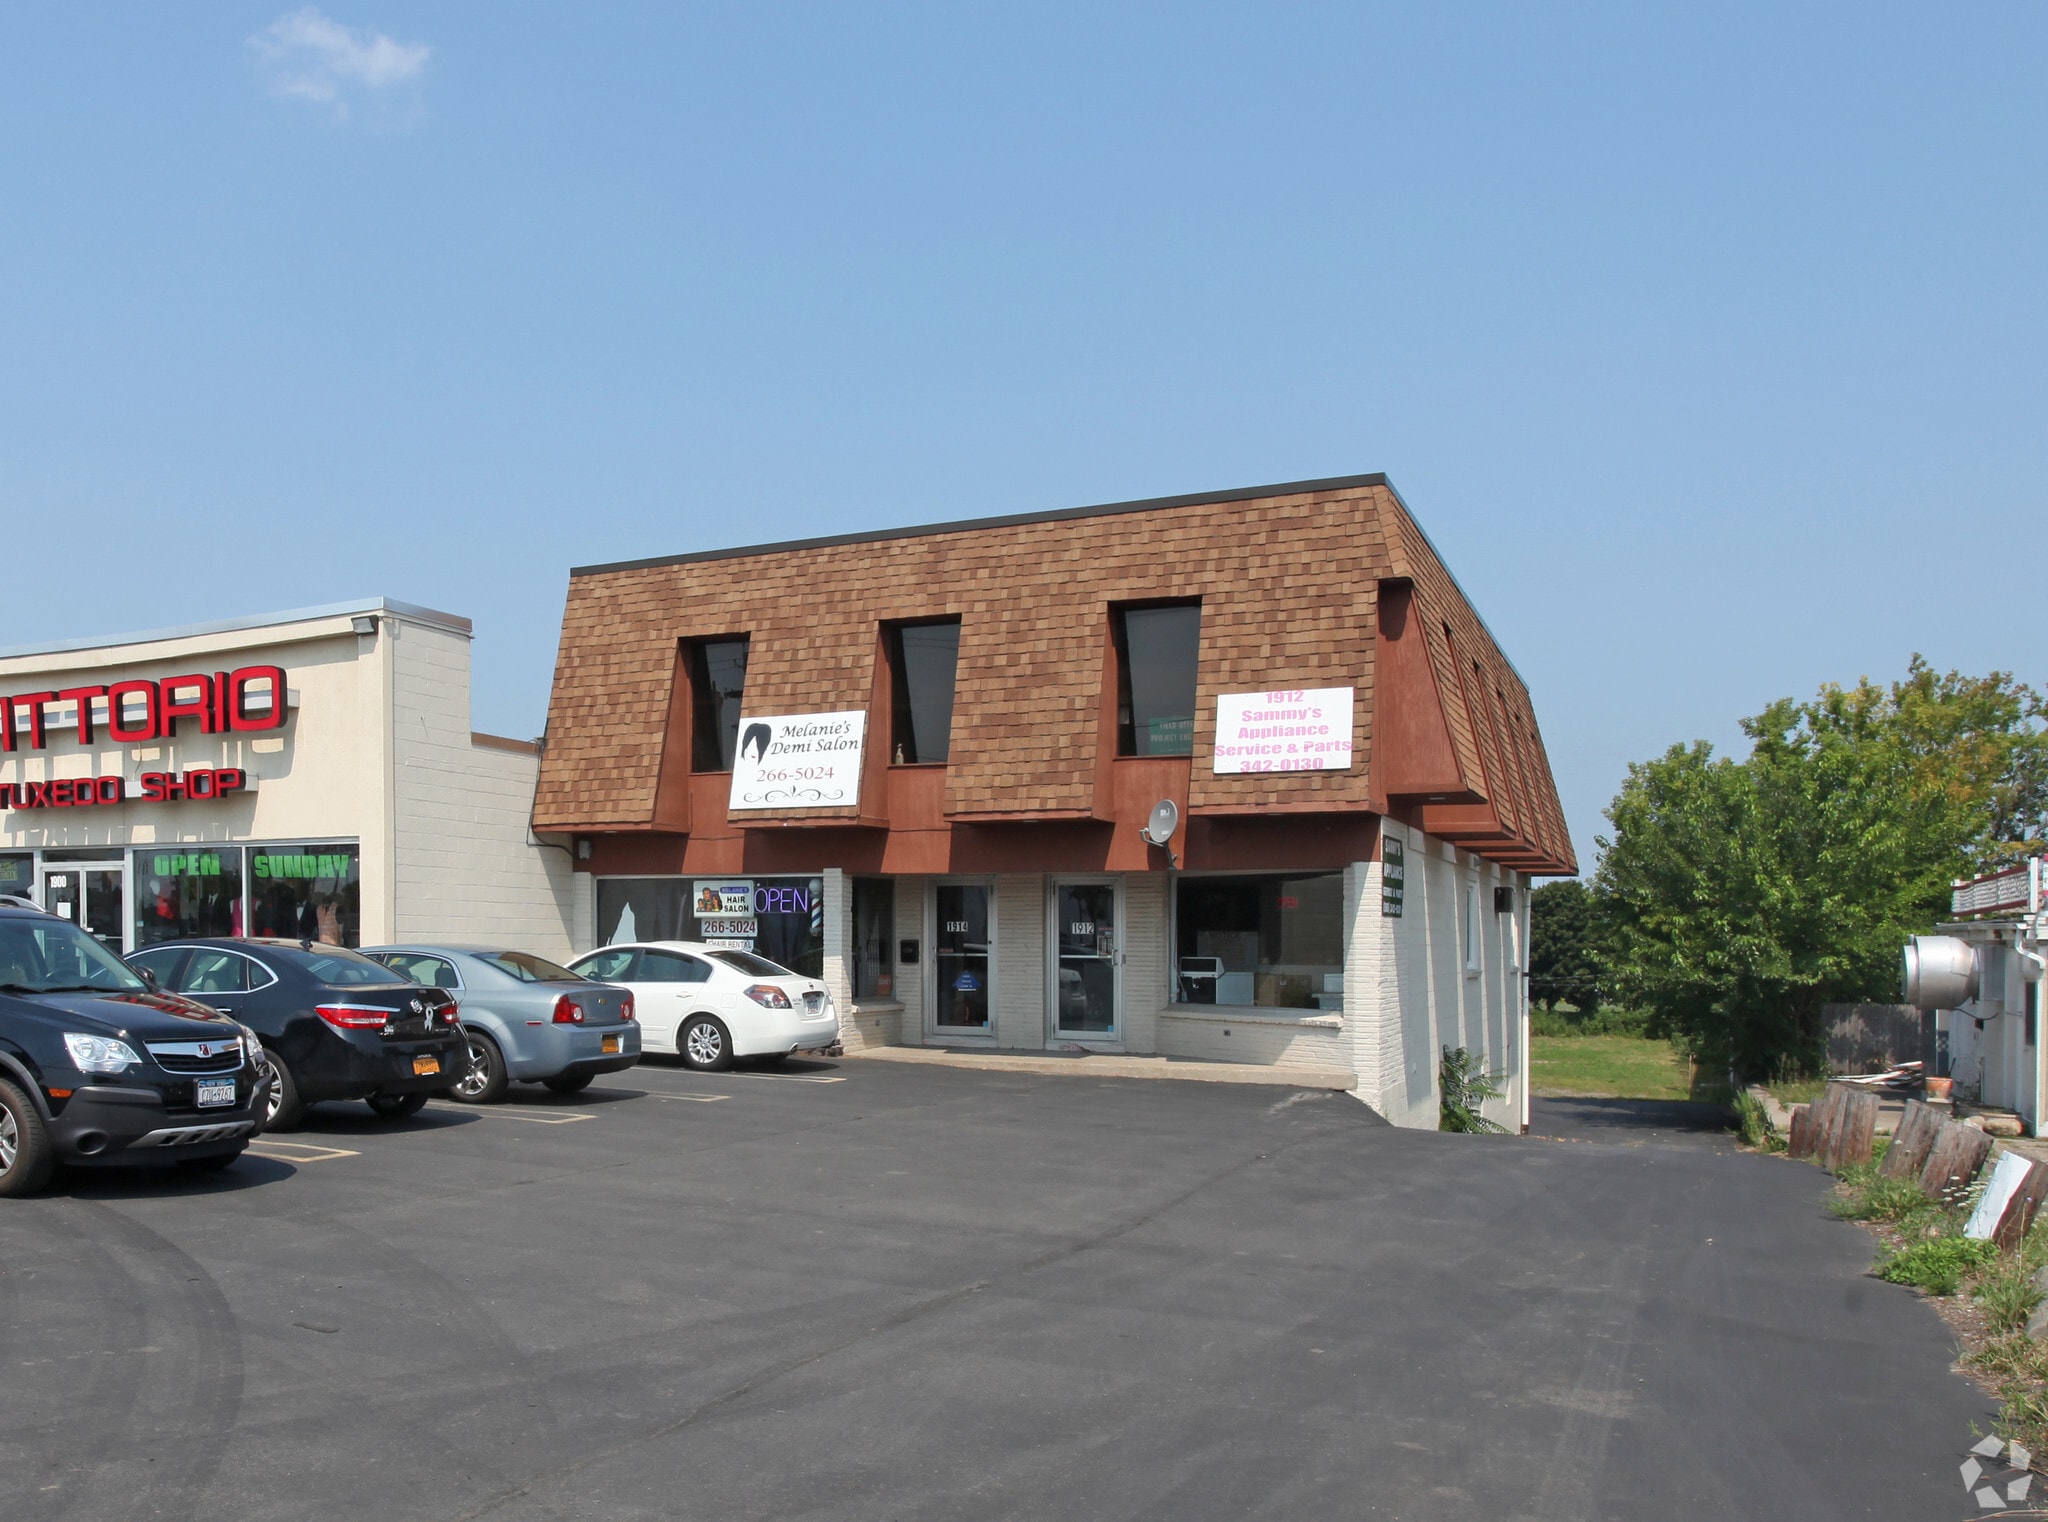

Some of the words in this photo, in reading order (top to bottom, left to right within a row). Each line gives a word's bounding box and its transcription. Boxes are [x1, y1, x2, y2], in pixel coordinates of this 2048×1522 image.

[1265, 690, 1304, 703] 1912
[1242, 707, 1322, 721] Sammy's
[779, 720, 851, 738] Melanie's
[1238, 724, 1329, 739] Appliance
[770, 739, 813, 755] Demi
[815, 736, 859, 752] Salon
[1215, 743, 1282, 757] Service
[1287, 743, 1299, 754] &
[1304, 740, 1353, 753] Parts
[1240, 757, 1324, 772] 342-0130
[756, 766, 834, 782] 266-5024
[141, 768, 245, 802] SHOP
[154, 853, 221, 876] OPEN
[254, 855, 350, 878] SUNDAY
[49, 875, 67, 888] 1900
[726, 895, 746, 904] HAIR
[754, 888, 808, 912] OPEN
[724, 905, 749, 913] SALON
[704, 920, 756, 933] 266-5024
[947, 921, 969, 932] 1914
[1072, 923, 1094, 934] 1912
